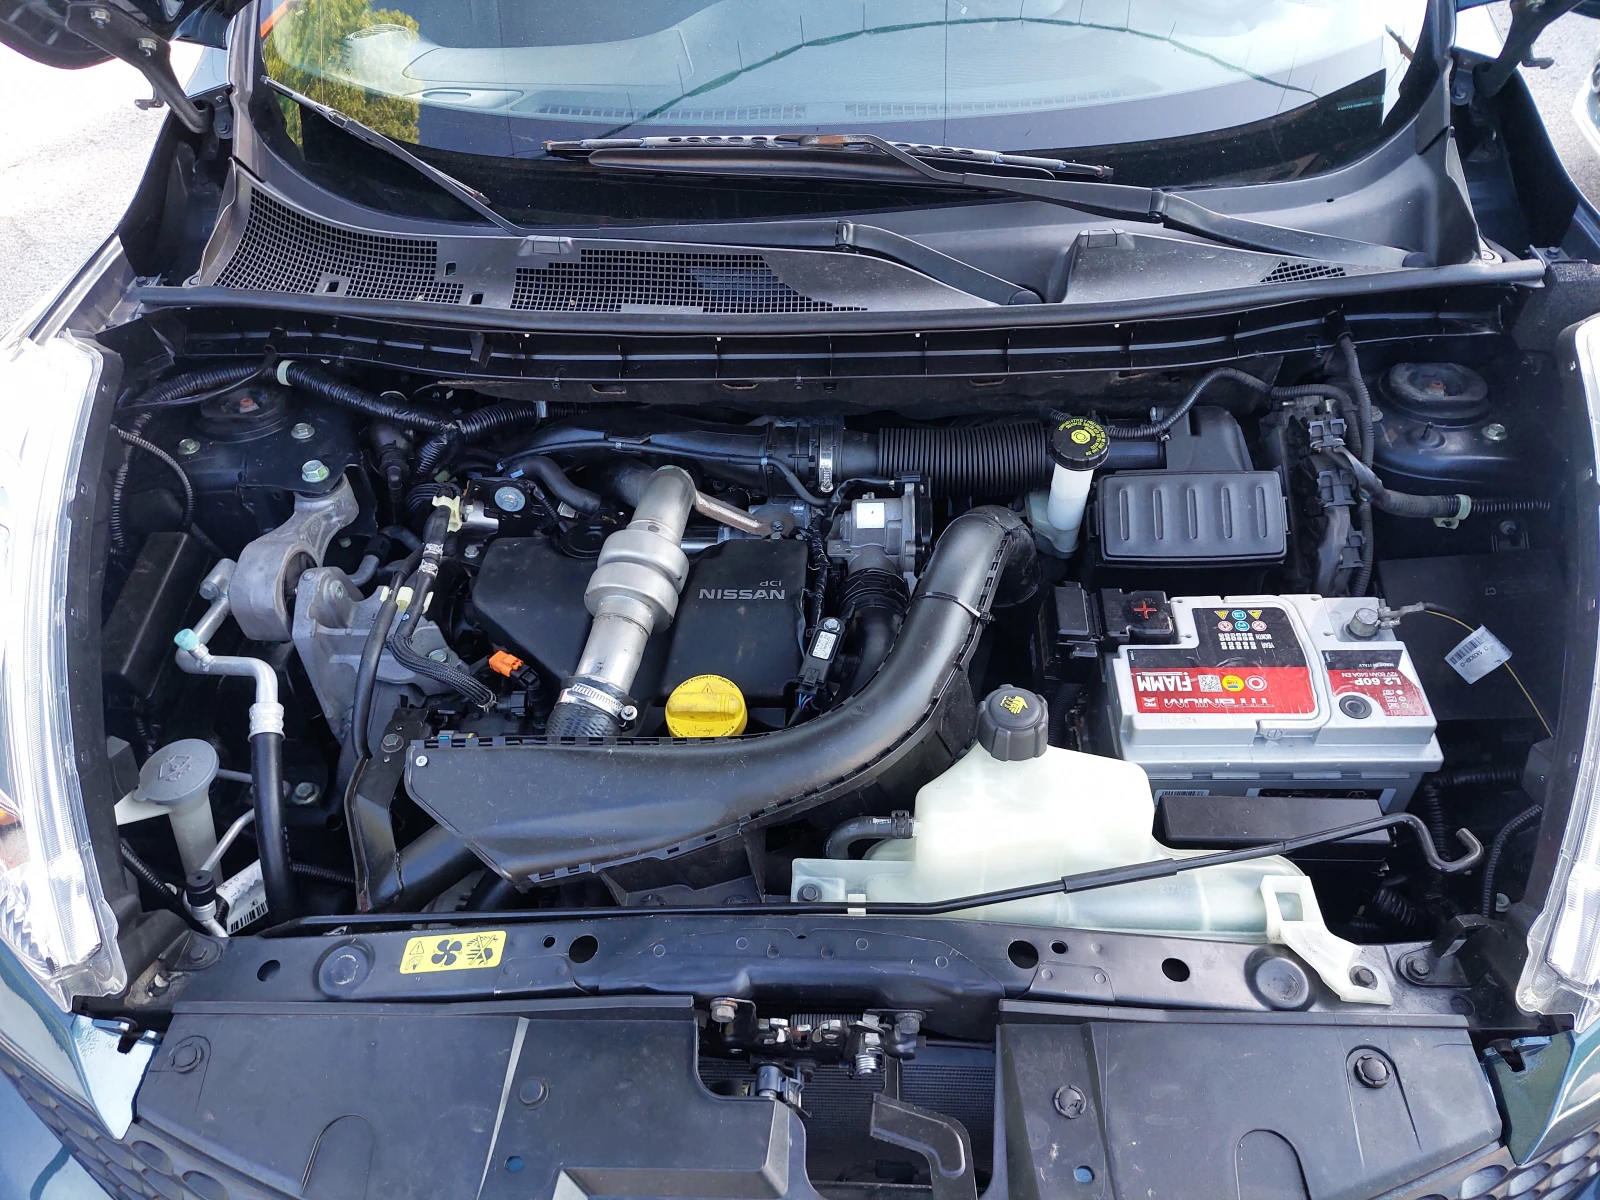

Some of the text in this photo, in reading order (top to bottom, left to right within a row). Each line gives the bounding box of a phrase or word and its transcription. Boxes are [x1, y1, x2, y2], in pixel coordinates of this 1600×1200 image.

[699, 589, 785, 600] NISSAN
[1261, 641, 1275, 649] YEAR
[1138, 675, 1192, 692] FIAMM
[1354, 677, 1402, 686] L2 60P
